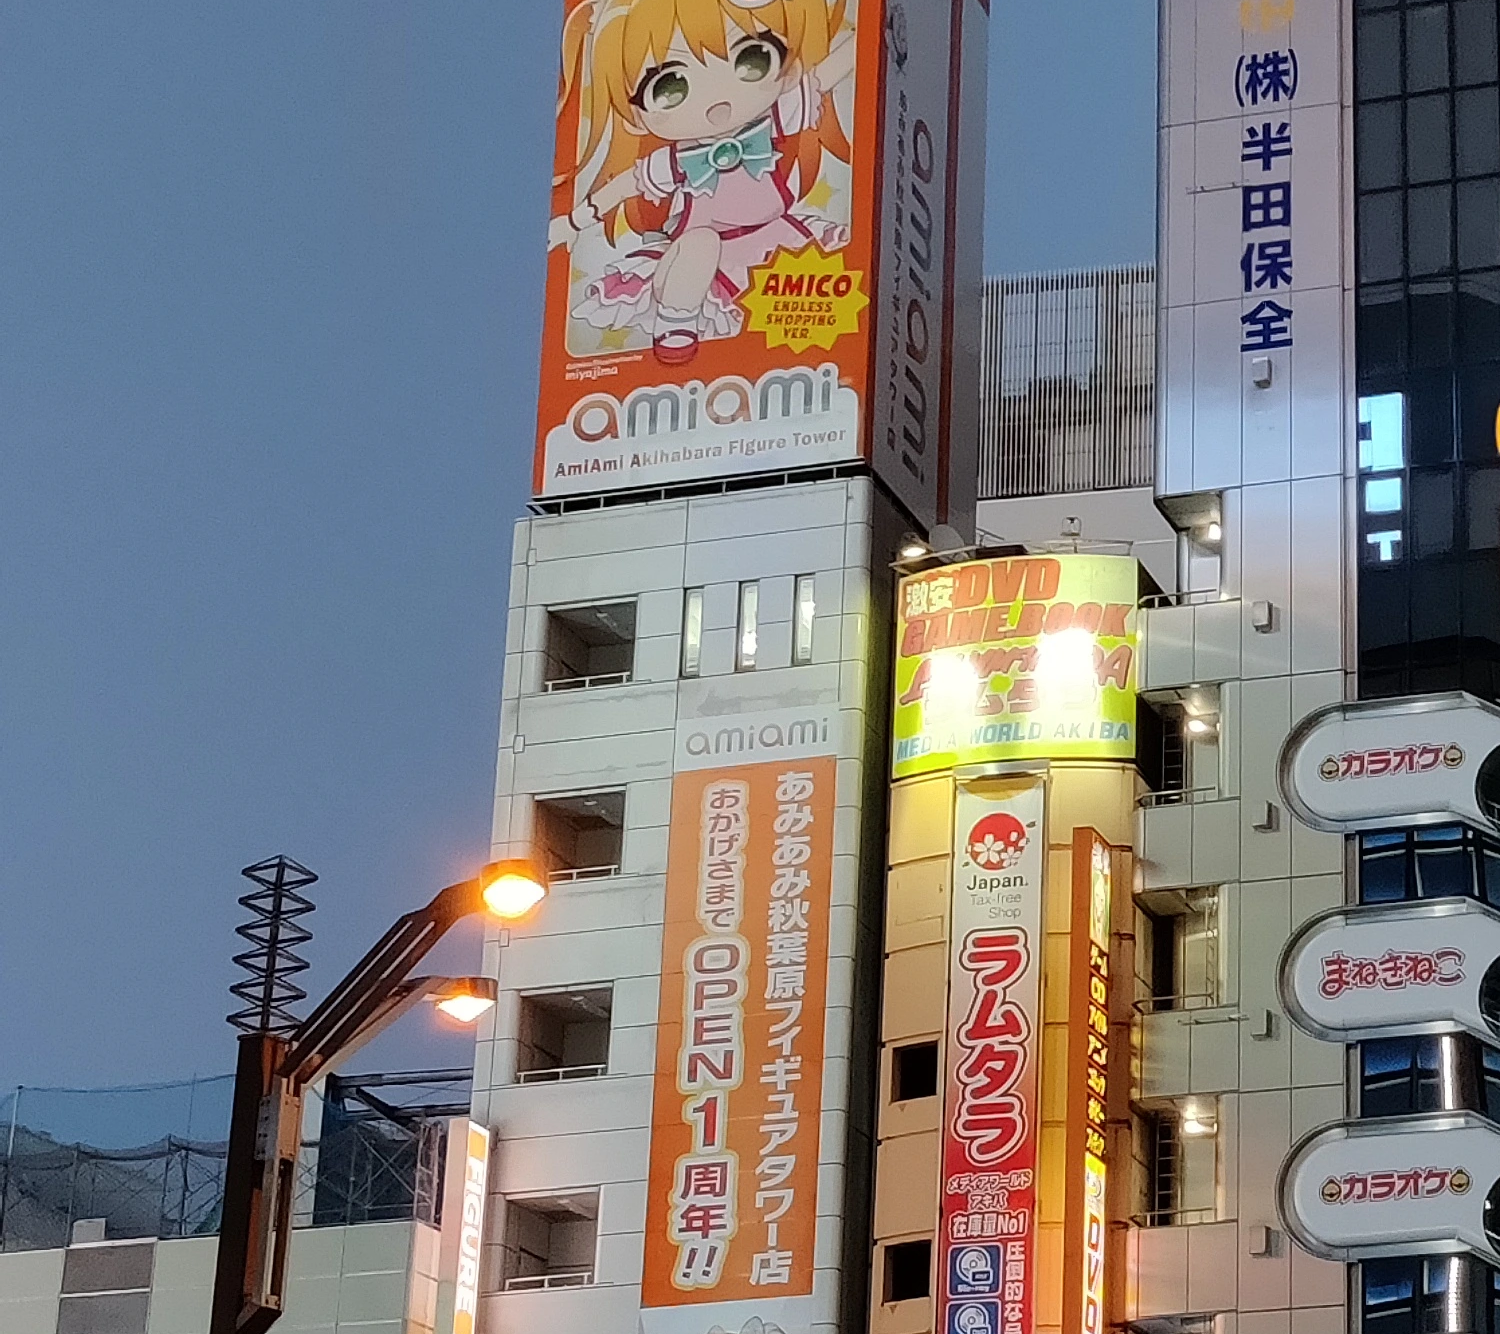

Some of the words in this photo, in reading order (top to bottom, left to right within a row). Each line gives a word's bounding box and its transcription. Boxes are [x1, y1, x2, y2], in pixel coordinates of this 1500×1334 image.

[761, 273, 852, 298] AMICO
[765, 313, 837, 327] SHOPPING
[772, 300, 833, 314] ENDLESS
[783, 326, 813, 340] VER.
[565, 365, 619, 382] miyajima
[571, 367, 833, 444] amiami
[554, 455, 624, 479] AmiAmi
[630, 443, 722, 468] Akihabara
[728, 436, 787, 457] Figure
[792, 427, 847, 448] Tower
[953, 558, 1061, 608] DVD
[900, 605, 1010, 658] GAME
[1013, 601, 1136, 644] BOOK
[685, 716, 829, 756] amiami
[896, 731, 957, 763] MEDIA
[969, 721, 1042, 745] WORLD
[1053, 720, 1130, 742] AKIBA
[1339, 745, 1443, 779] カラオケ
[966, 874, 1030, 893] Japan.
[988, 906, 1023, 919] Shop
[1319, 948, 1466, 999] まねきねこ
[748, 769, 815, 1286] あみあみ秋葉原フィギュアタワー店
[961, 929, 1027, 1162] ラムタラ
[946, 1169, 1033, 1195] メディアワールド
[1341, 1170, 1450, 1201] カラオケ
[456, 1156, 481, 1316] FIGURE
